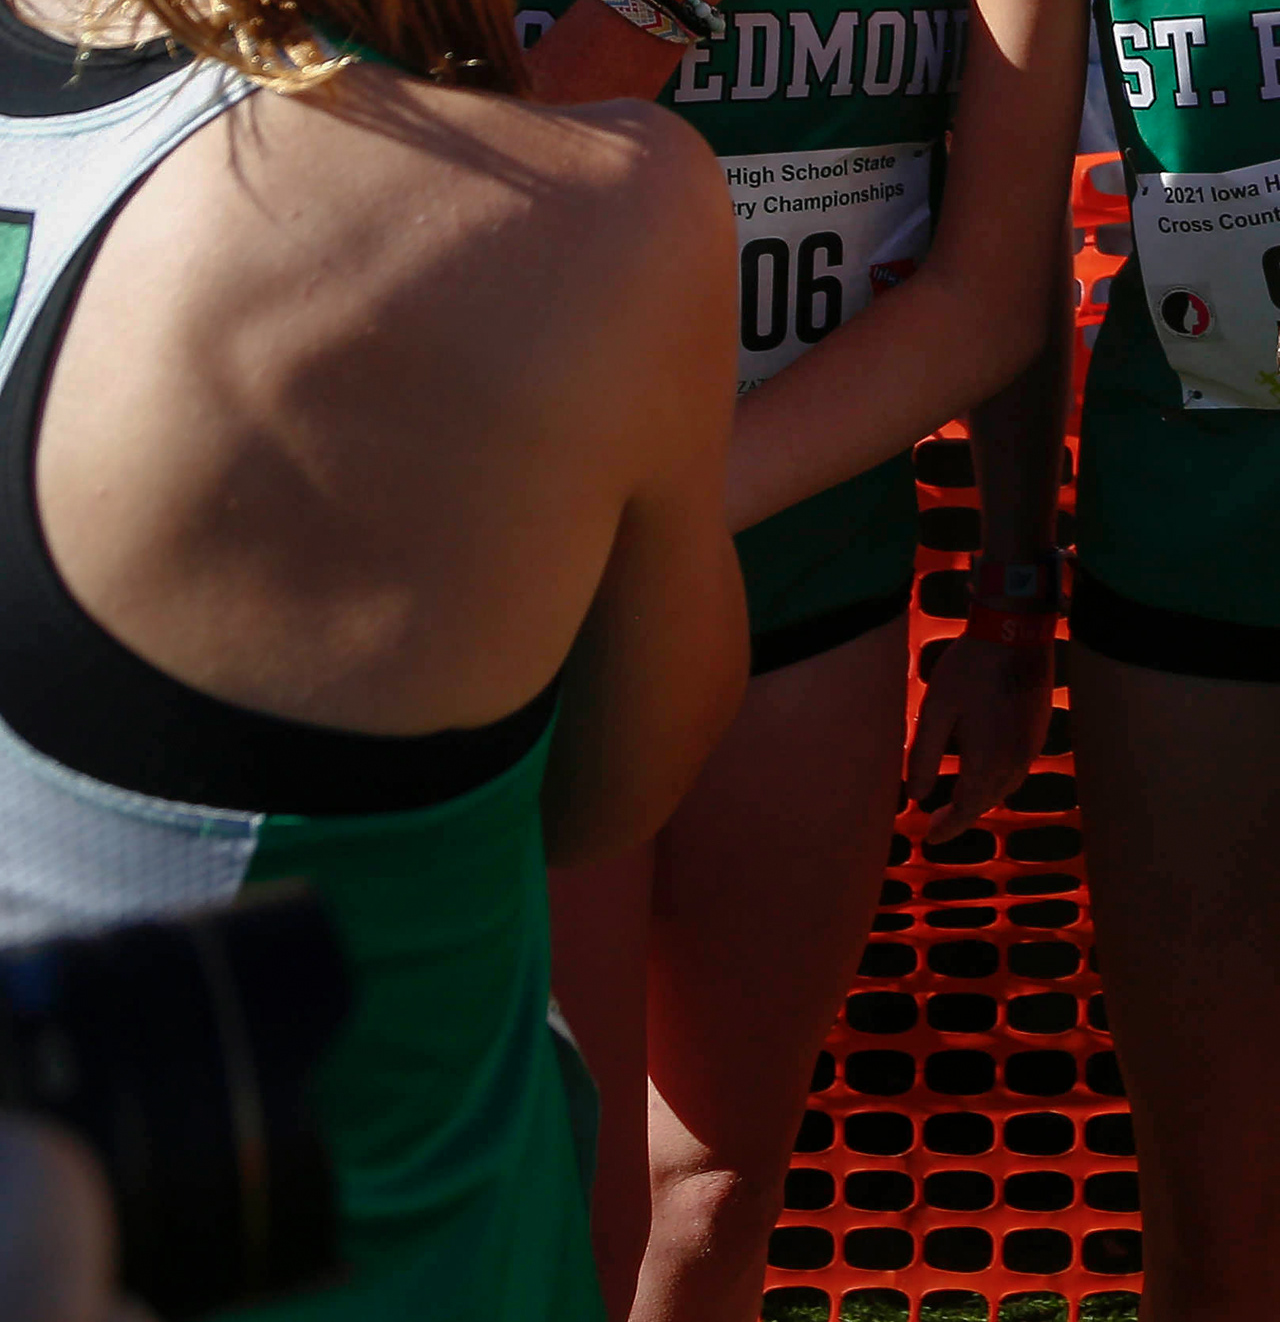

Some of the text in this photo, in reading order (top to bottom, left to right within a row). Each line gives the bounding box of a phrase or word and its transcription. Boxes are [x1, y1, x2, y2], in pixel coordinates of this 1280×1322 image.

[1111, 15, 1229, 110] ST.
[726, 154, 896, 188] High School State
[763, 181, 905, 214] Championships
[1163, 184, 1206, 205] 2021
[1211, 181, 1260, 204] Iowa
[1157, 212, 1214, 234] Cross
